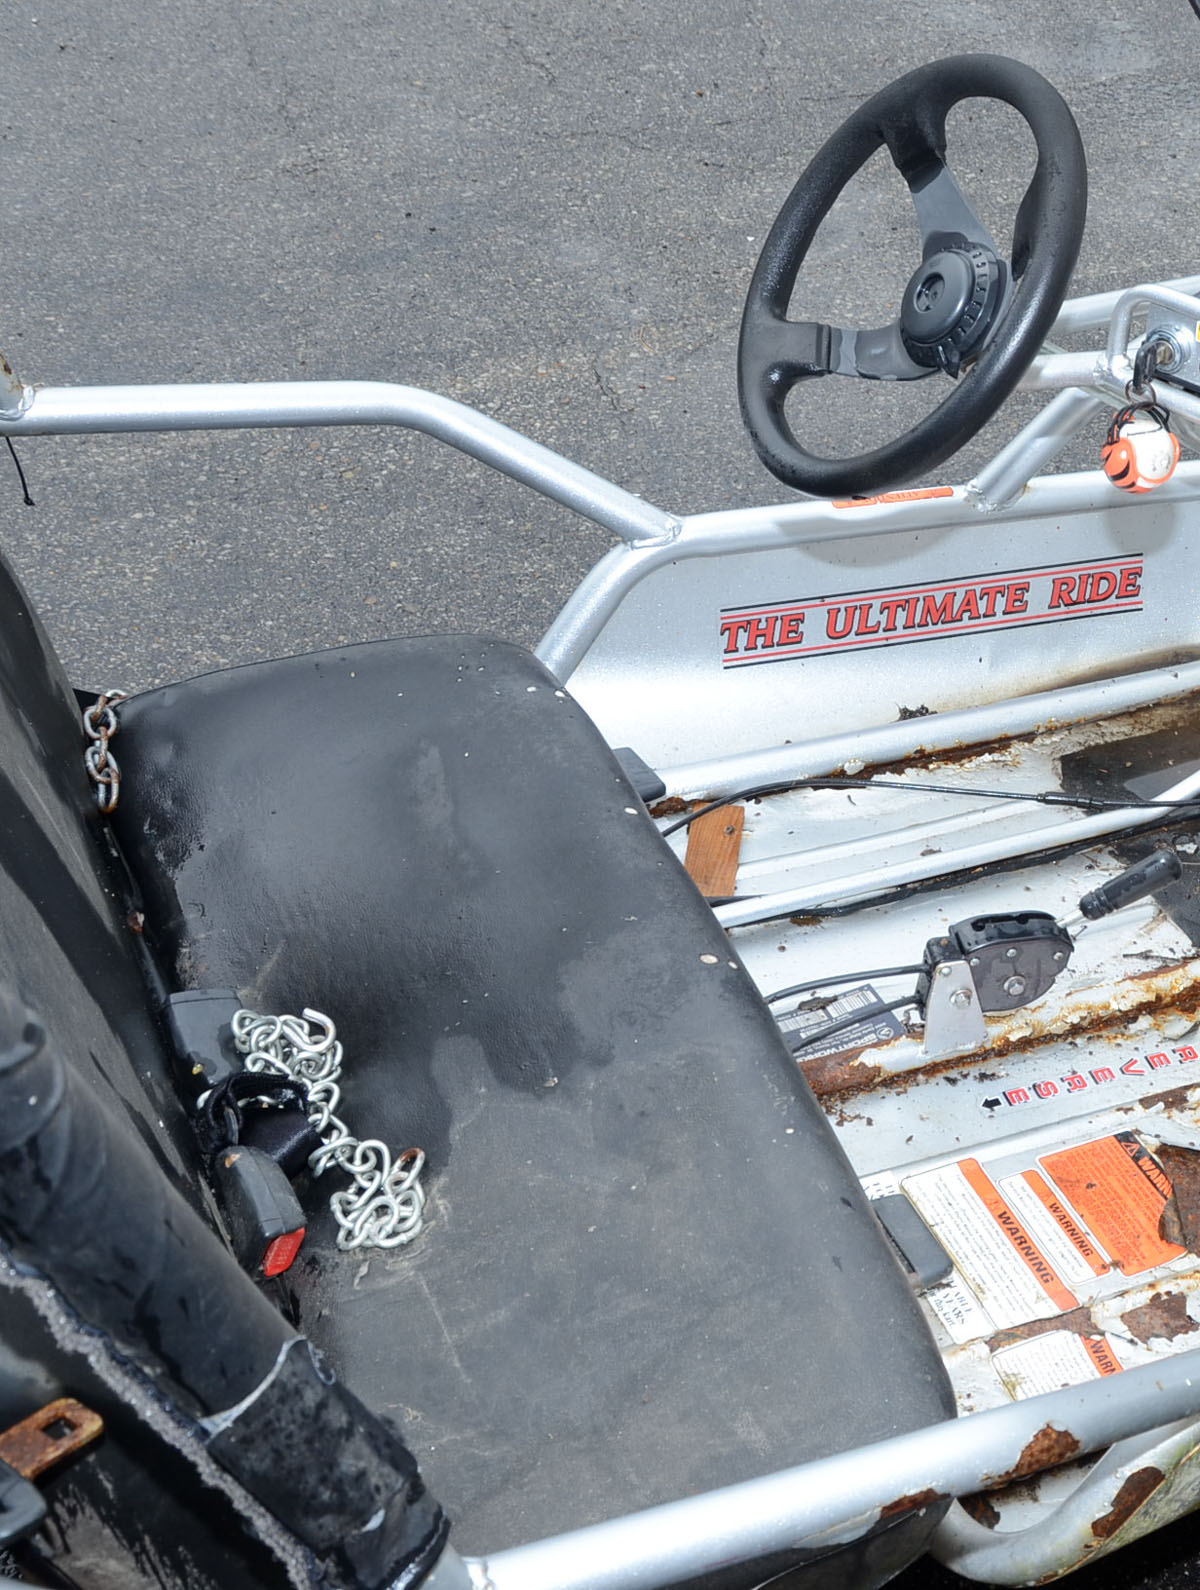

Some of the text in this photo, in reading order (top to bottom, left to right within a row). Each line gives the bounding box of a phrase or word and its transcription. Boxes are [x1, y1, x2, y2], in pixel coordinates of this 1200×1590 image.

[720, 566, 1143, 654] THE ULTIMATE RIDE
[1003, 1045, 1200, 1107] REVERSE
[998, 1210, 1055, 1284] WARNING
[1048, 1202, 1094, 1257] WARNING
